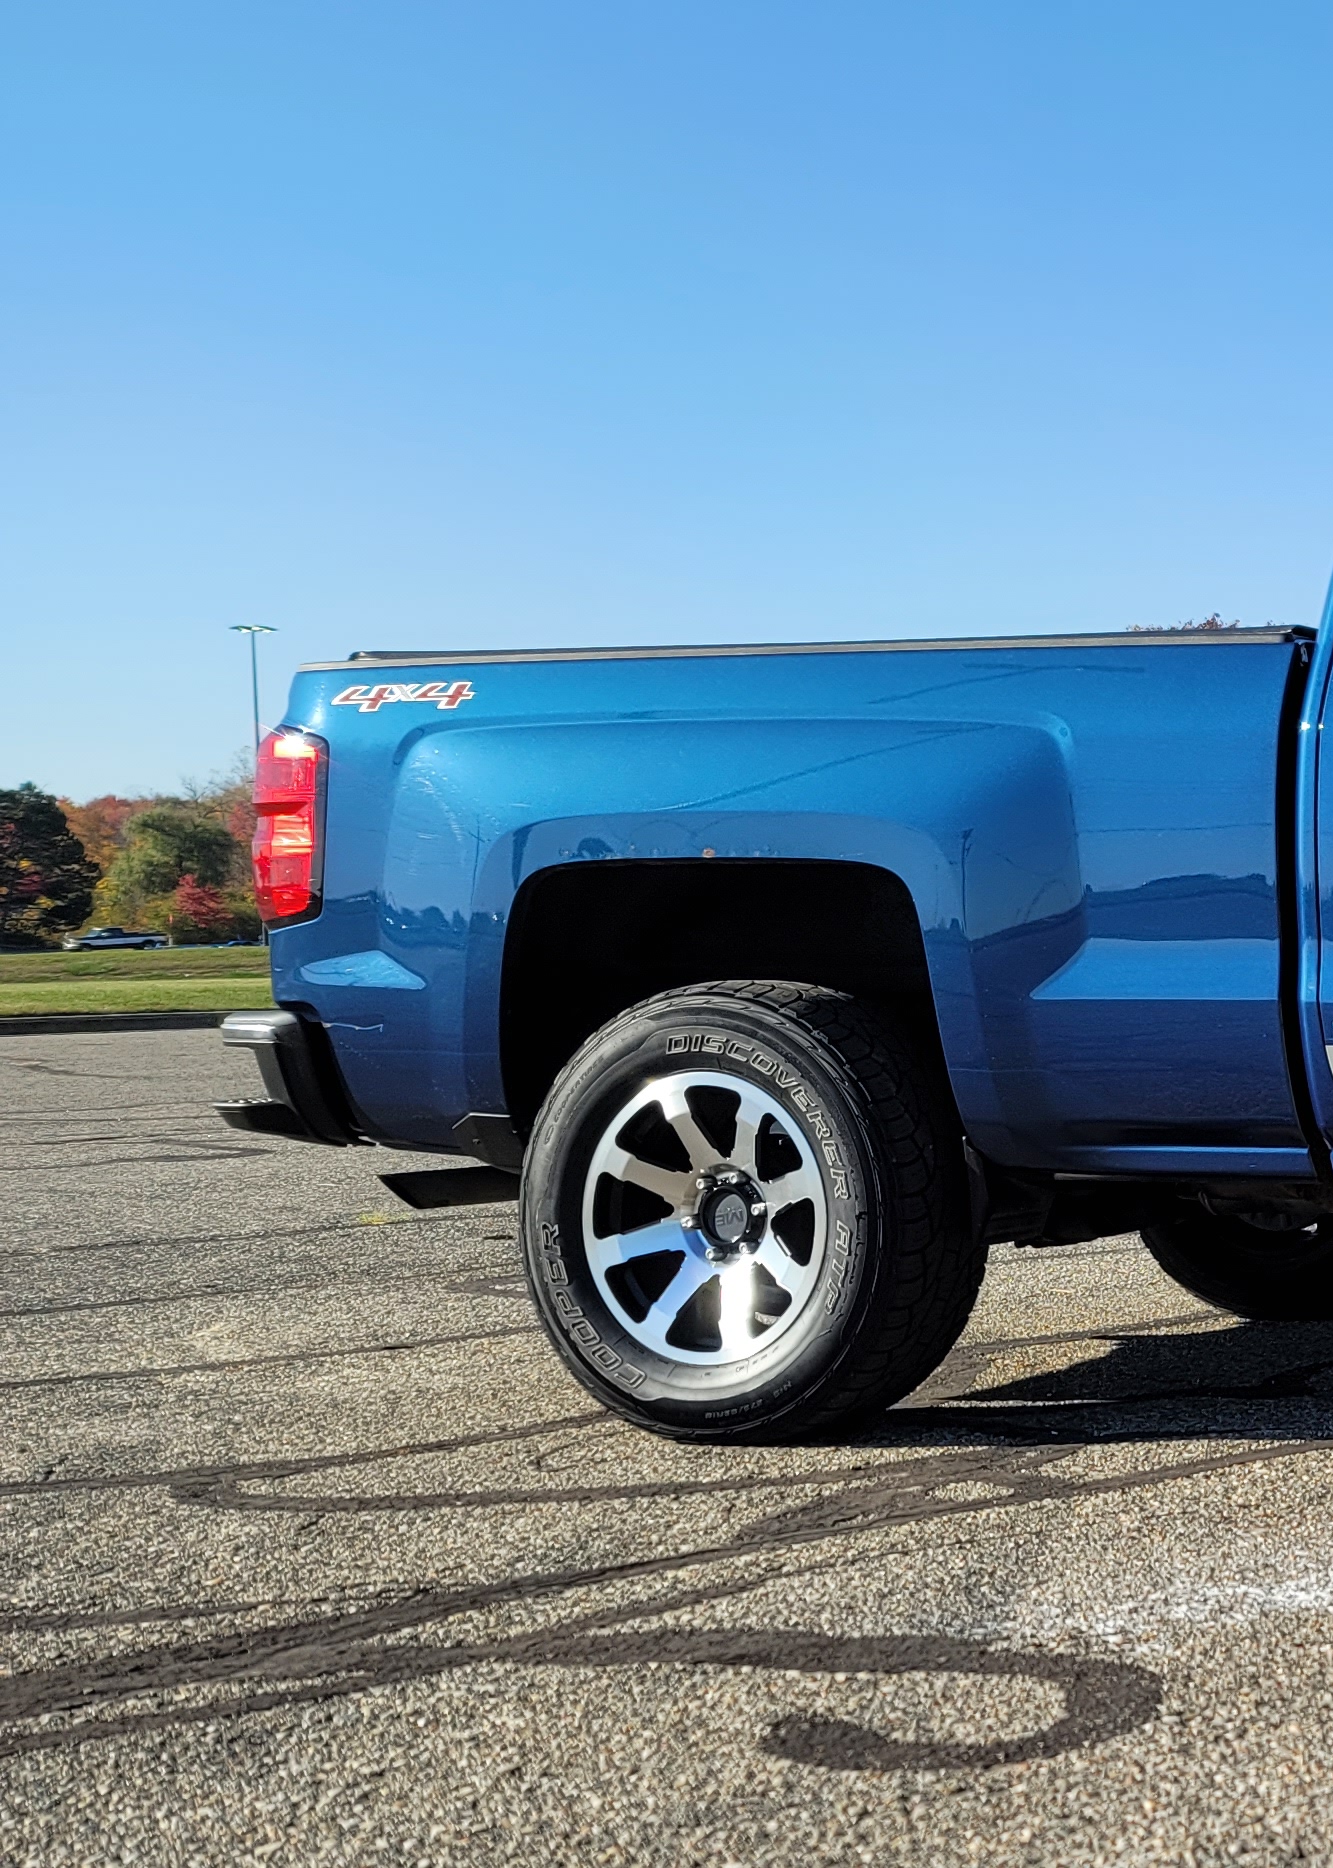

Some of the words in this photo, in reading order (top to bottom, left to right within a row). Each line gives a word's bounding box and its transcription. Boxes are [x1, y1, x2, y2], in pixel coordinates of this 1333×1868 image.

[666, 1033, 849, 1200] DISCOVERER
[825, 1218, 853, 1318] ATP
[540, 1221, 648, 1390] COOPER
